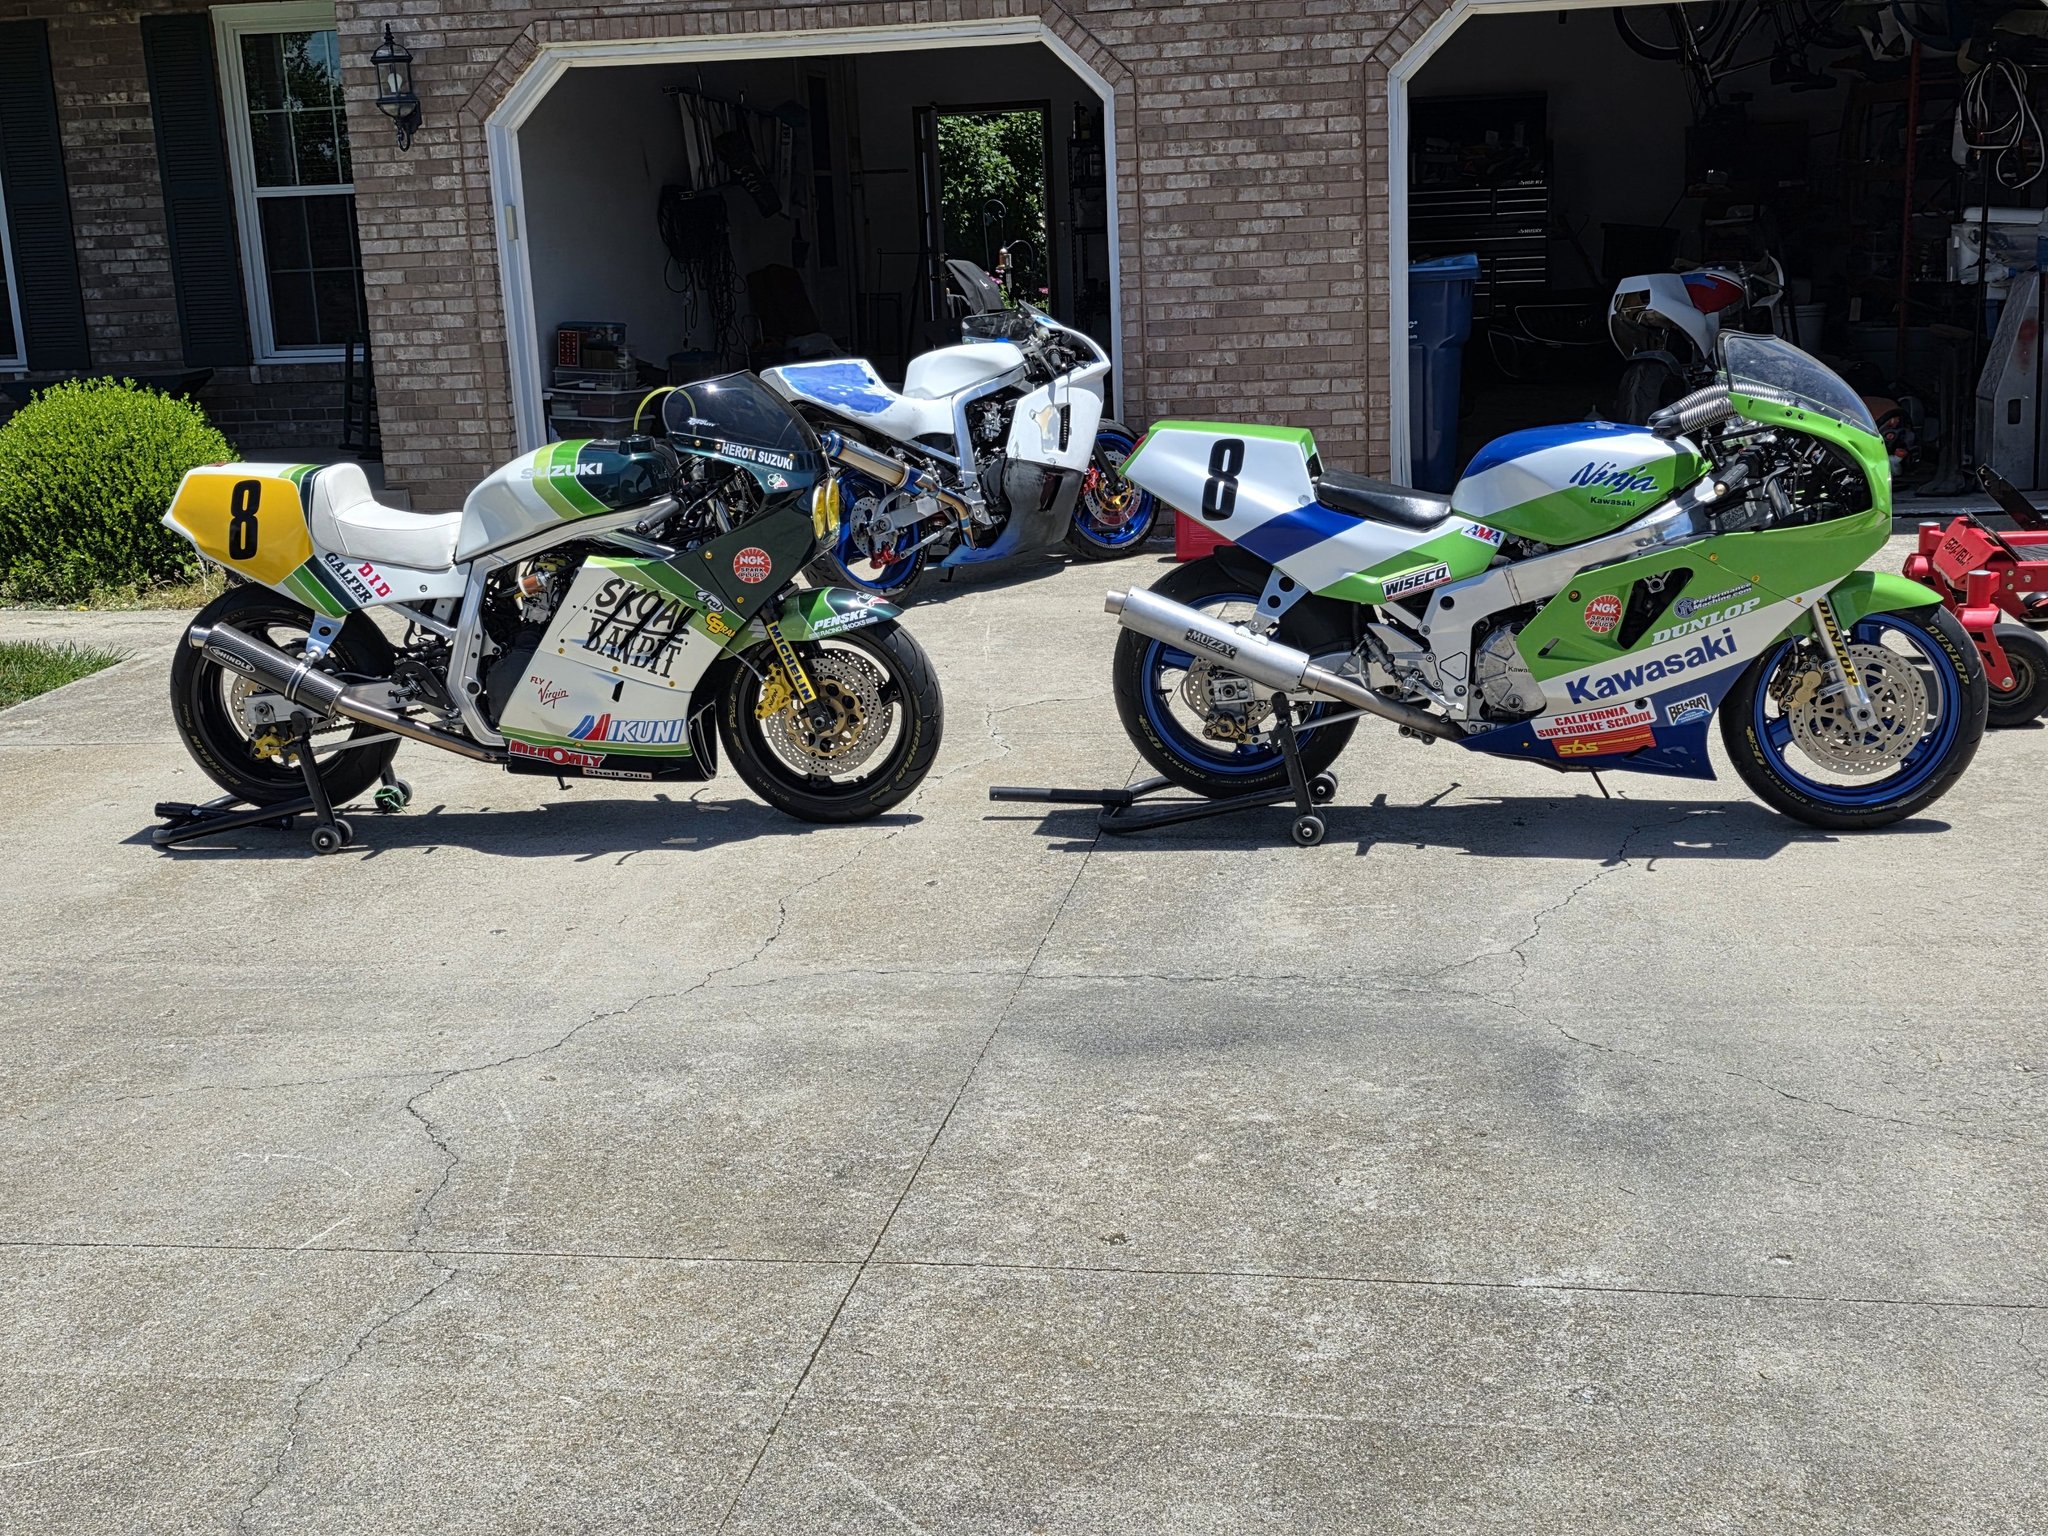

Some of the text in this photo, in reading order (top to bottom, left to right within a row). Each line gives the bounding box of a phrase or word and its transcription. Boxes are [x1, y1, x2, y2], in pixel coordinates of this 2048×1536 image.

[721, 442, 793, 471] HERON SUZUKI
[520, 462, 603, 480] SUZUKI
[1202, 438, 1245, 521] 8
[1569, 461, 1658, 497] Ninja
[1590, 496, 1636, 507] Kawasaki
[229, 479, 261, 560] 8
[1465, 524, 1502, 544] AMA
[740, 556, 765, 565] NGK
[324, 552, 373, 603] GALFER
[1385, 566, 1447, 596] WISECO
[1693, 582, 1752, 604] Performance
[1693, 587, 1752, 610] Machine.com
[813, 608, 868, 631] PENSKE
[1592, 603, 1618, 614] NGK
[820, 619, 866, 636] RACING SHOCKS
[1590, 621, 1616, 629] PLUGS
[1651, 597, 1760, 646] DUNLOP
[582, 617, 682, 679] BANDIT
[1189, 630, 1234, 655] MUZZY
[1816, 598, 1859, 686] DUNLOP
[769, 624, 813, 701] MICHELIN
[1565, 627, 1738, 705] Kawasaki
[1925, 625, 1970, 686] DUNLOP
[530, 676, 545, 686] FLY
[537, 680, 569, 709] Virgin
[1537, 710, 1655, 738] SUPERBIKE SCHOOL
[1554, 705, 1629, 727] CALIFORNIA
[1558, 739, 1599, 755] sbs
[585, 769, 650, 779] Shell Oils
